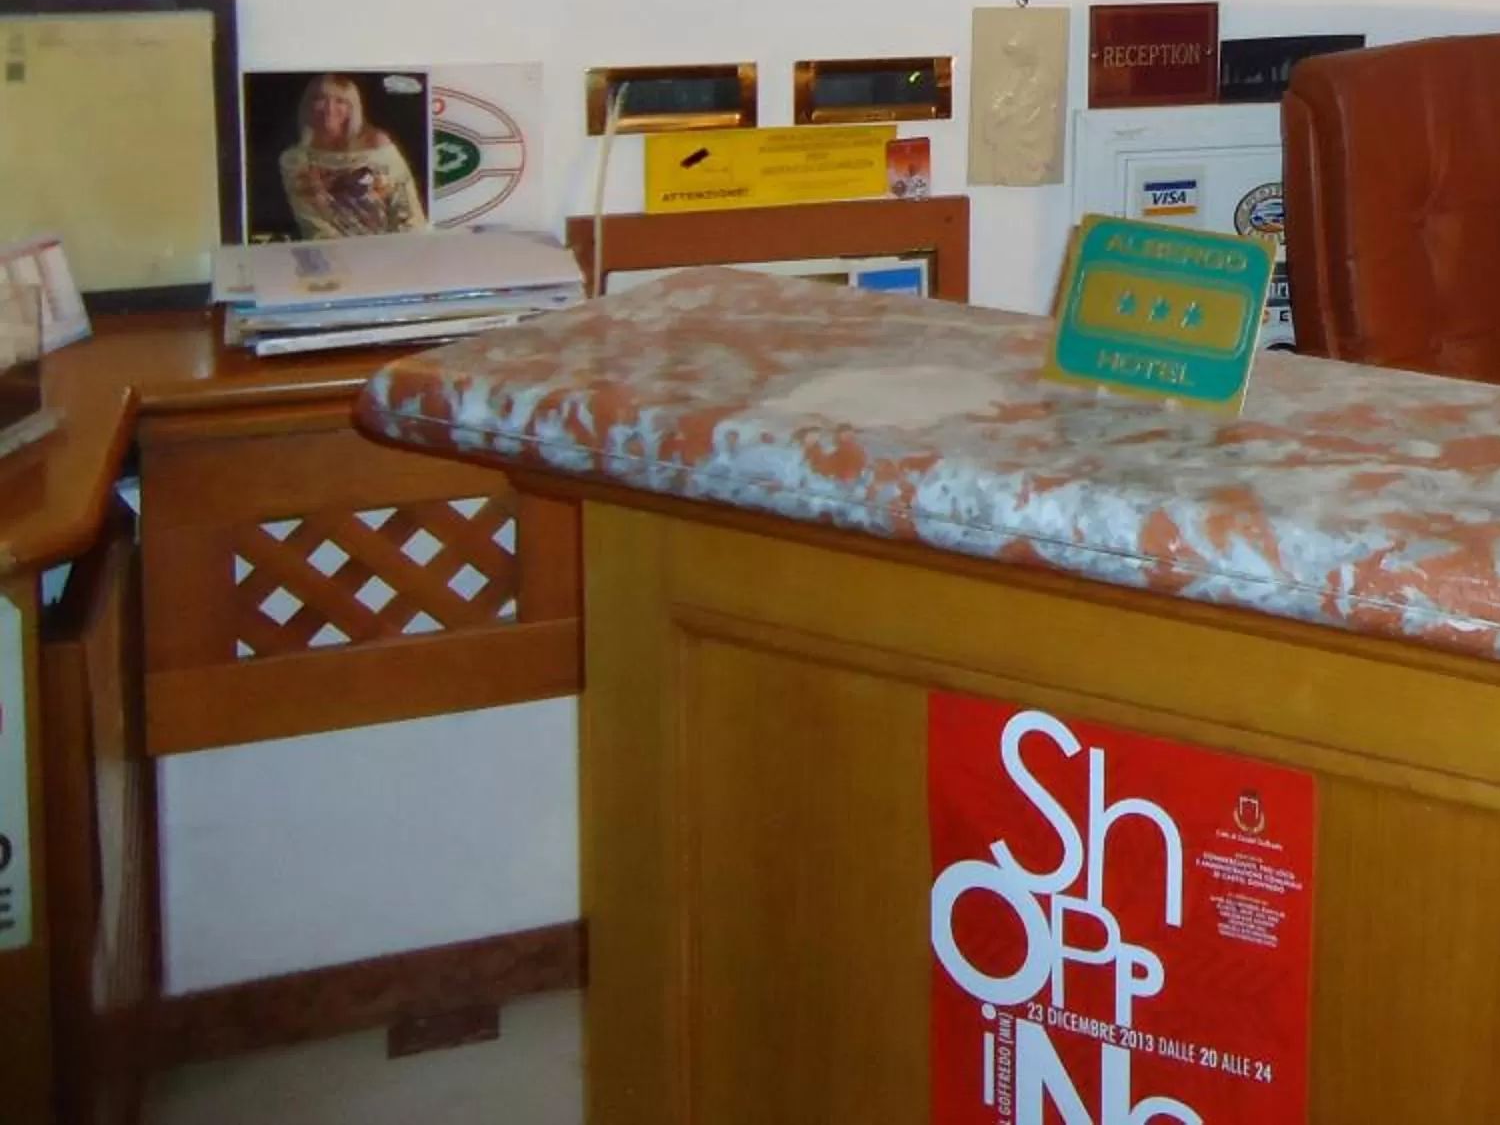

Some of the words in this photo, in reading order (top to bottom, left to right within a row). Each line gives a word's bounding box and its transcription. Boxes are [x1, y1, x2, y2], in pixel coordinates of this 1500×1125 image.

[1103, 42, 1201, 68] RECEPTION
[1151, 190, 1188, 205] VISA
[1105, 234, 1248, 271] ALBERGO
[1097, 349, 1194, 386] HOTEL
[1027, 1002, 1044, 1023] 23
[1047, 1007, 1117, 1044] DICEMBRE
[1119, 1028, 1155, 1052] 2013
[1158, 1037, 1196, 1063] DALLE
[1199, 1047, 1217, 1068] 20
[1221, 1052, 1250, 1076] ALLE
[1254, 1061, 1273, 1083] 24
